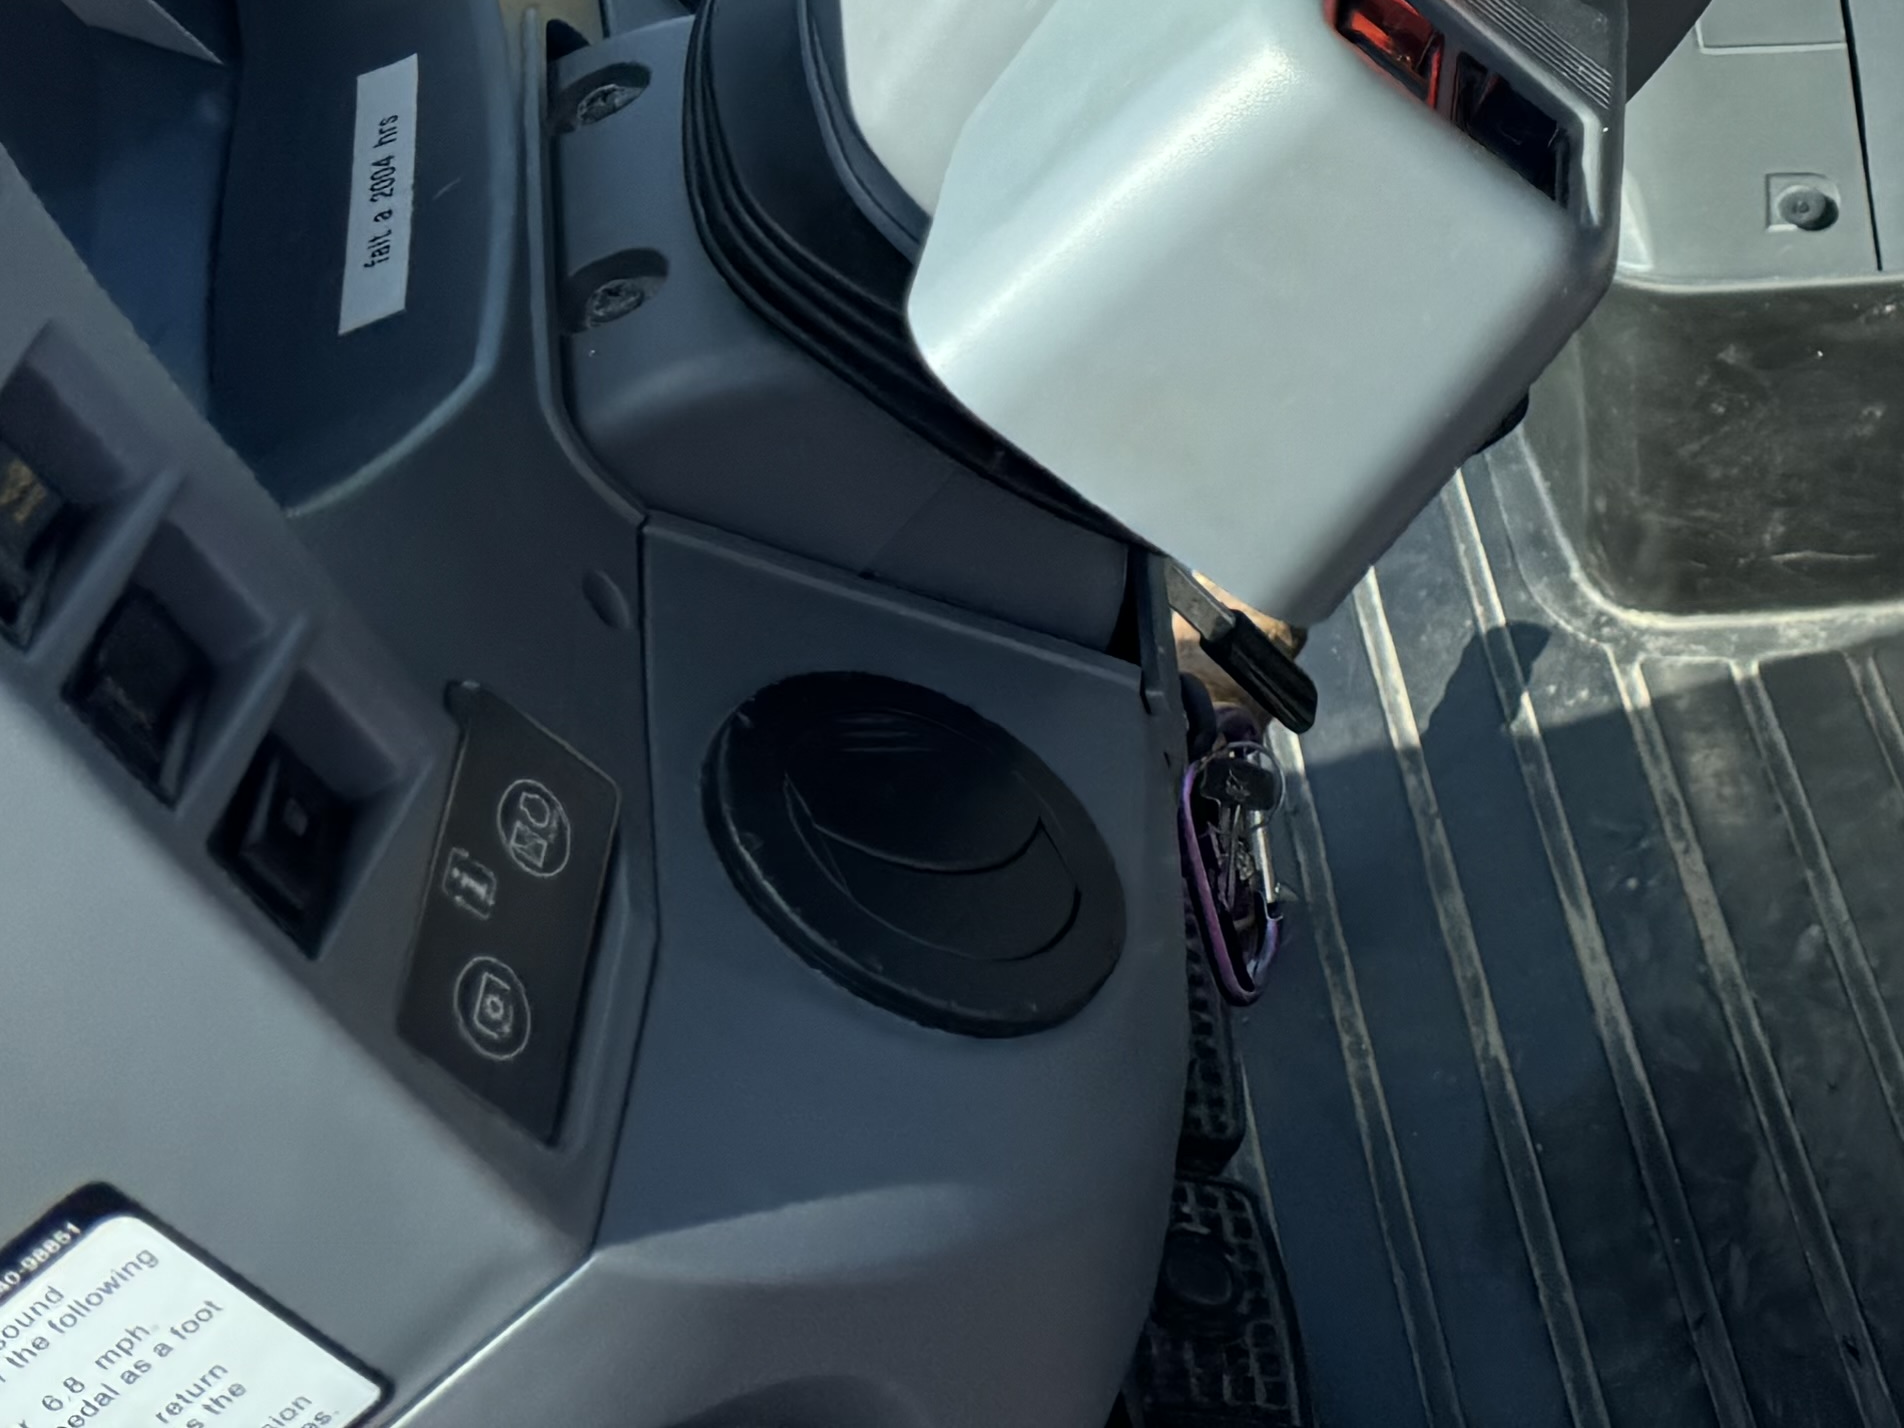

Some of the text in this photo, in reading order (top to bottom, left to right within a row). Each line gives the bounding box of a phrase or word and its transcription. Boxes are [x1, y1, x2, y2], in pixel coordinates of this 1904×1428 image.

[374, 114, 399, 149] hrs
[369, 154, 396, 202] 2004
[373, 209, 392, 221] a
[6, 1334, 50, 1370] the
[49, 1246, 160, 1335] following
[57, 1299, 225, 1428] edal as a foot
[155, 1361, 230, 1426] return
[201, 1380, 248, 1418] the
